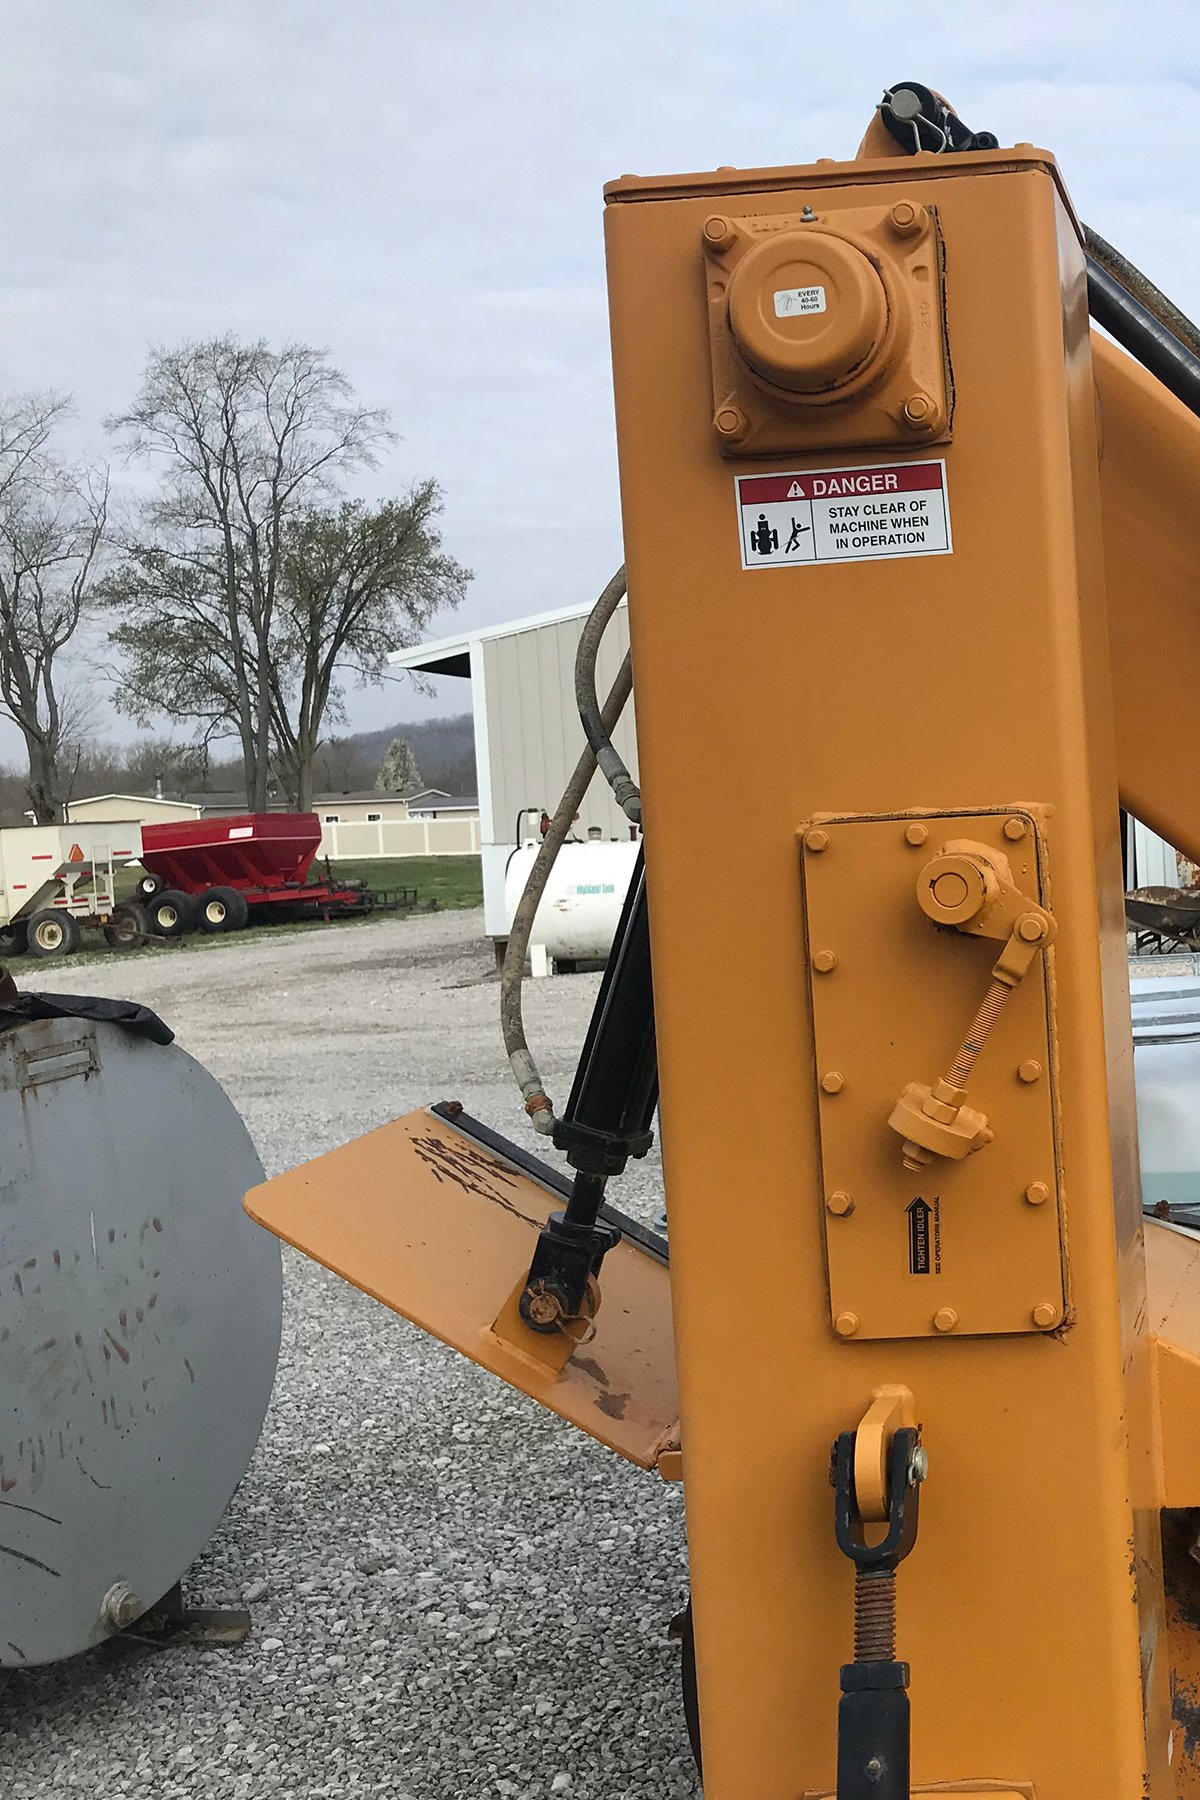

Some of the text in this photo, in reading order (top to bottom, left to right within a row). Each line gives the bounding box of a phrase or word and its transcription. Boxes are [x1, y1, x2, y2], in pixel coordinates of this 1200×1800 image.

[798, 289, 820, 297] EVERY
[812, 473, 899, 496] DANGER
[829, 500, 927, 518] STAY CLEAR OF
[829, 516, 929, 534] MACHINE WHEN
[836, 532, 925, 549] IN OPERATION
[916, 1207, 925, 1270] TIGHTEN IDLER
